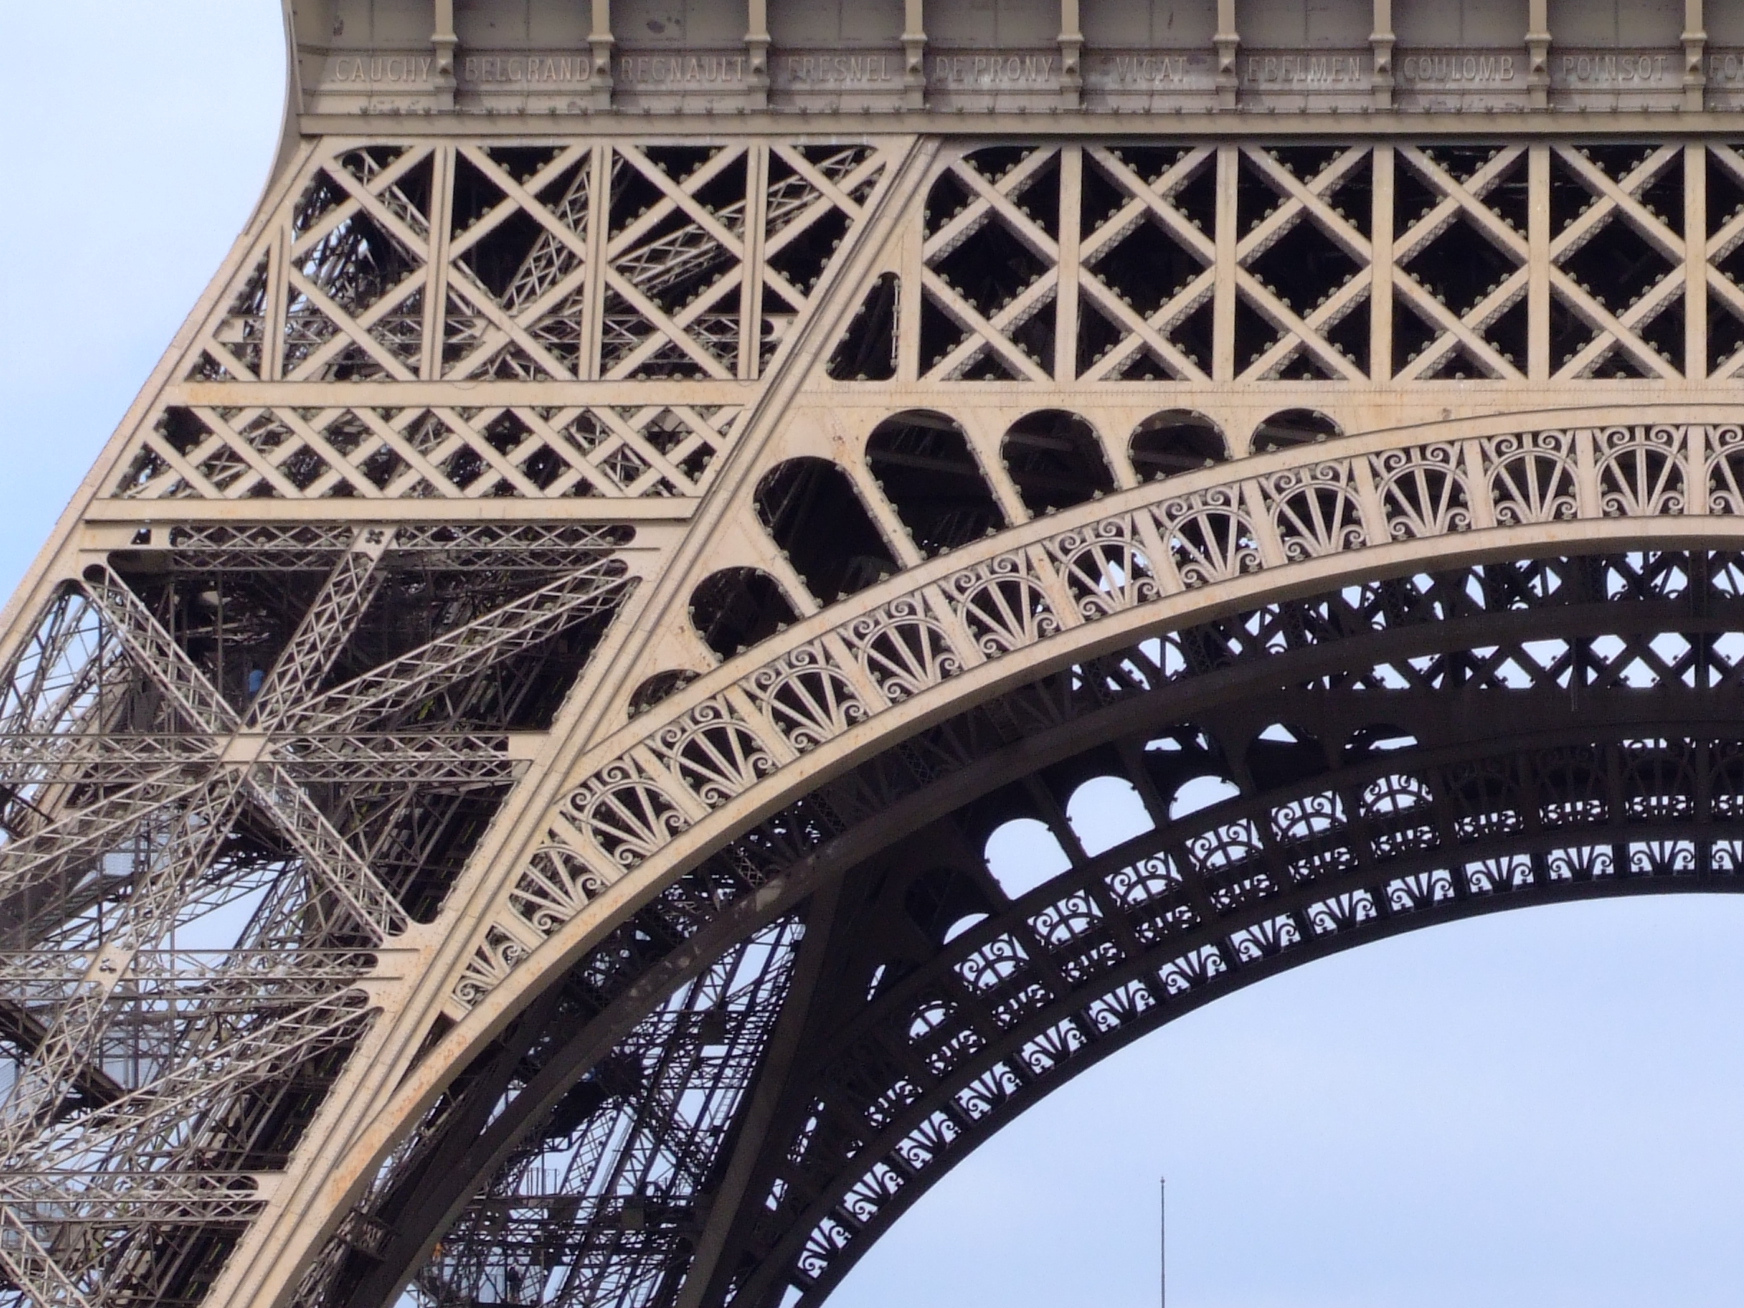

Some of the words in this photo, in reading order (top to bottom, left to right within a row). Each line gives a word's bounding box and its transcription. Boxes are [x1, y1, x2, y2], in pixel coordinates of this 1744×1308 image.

[335, 57, 432, 82] CAUCHY
[464, 57, 591, 82] BELGRAND
[621, 56, 746, 82] REGNAULT
[787, 56, 891, 82] FRESNEL
[935, 57, 965, 82] DE
[974, 57, 1054, 82] PRONY
[1115, 57, 1187, 83] VICAT
[1247, 57, 1361, 82] EBELMEN
[1403, 56, 1514, 81] COULOMB
[1562, 55, 1667, 81] POINSOT
